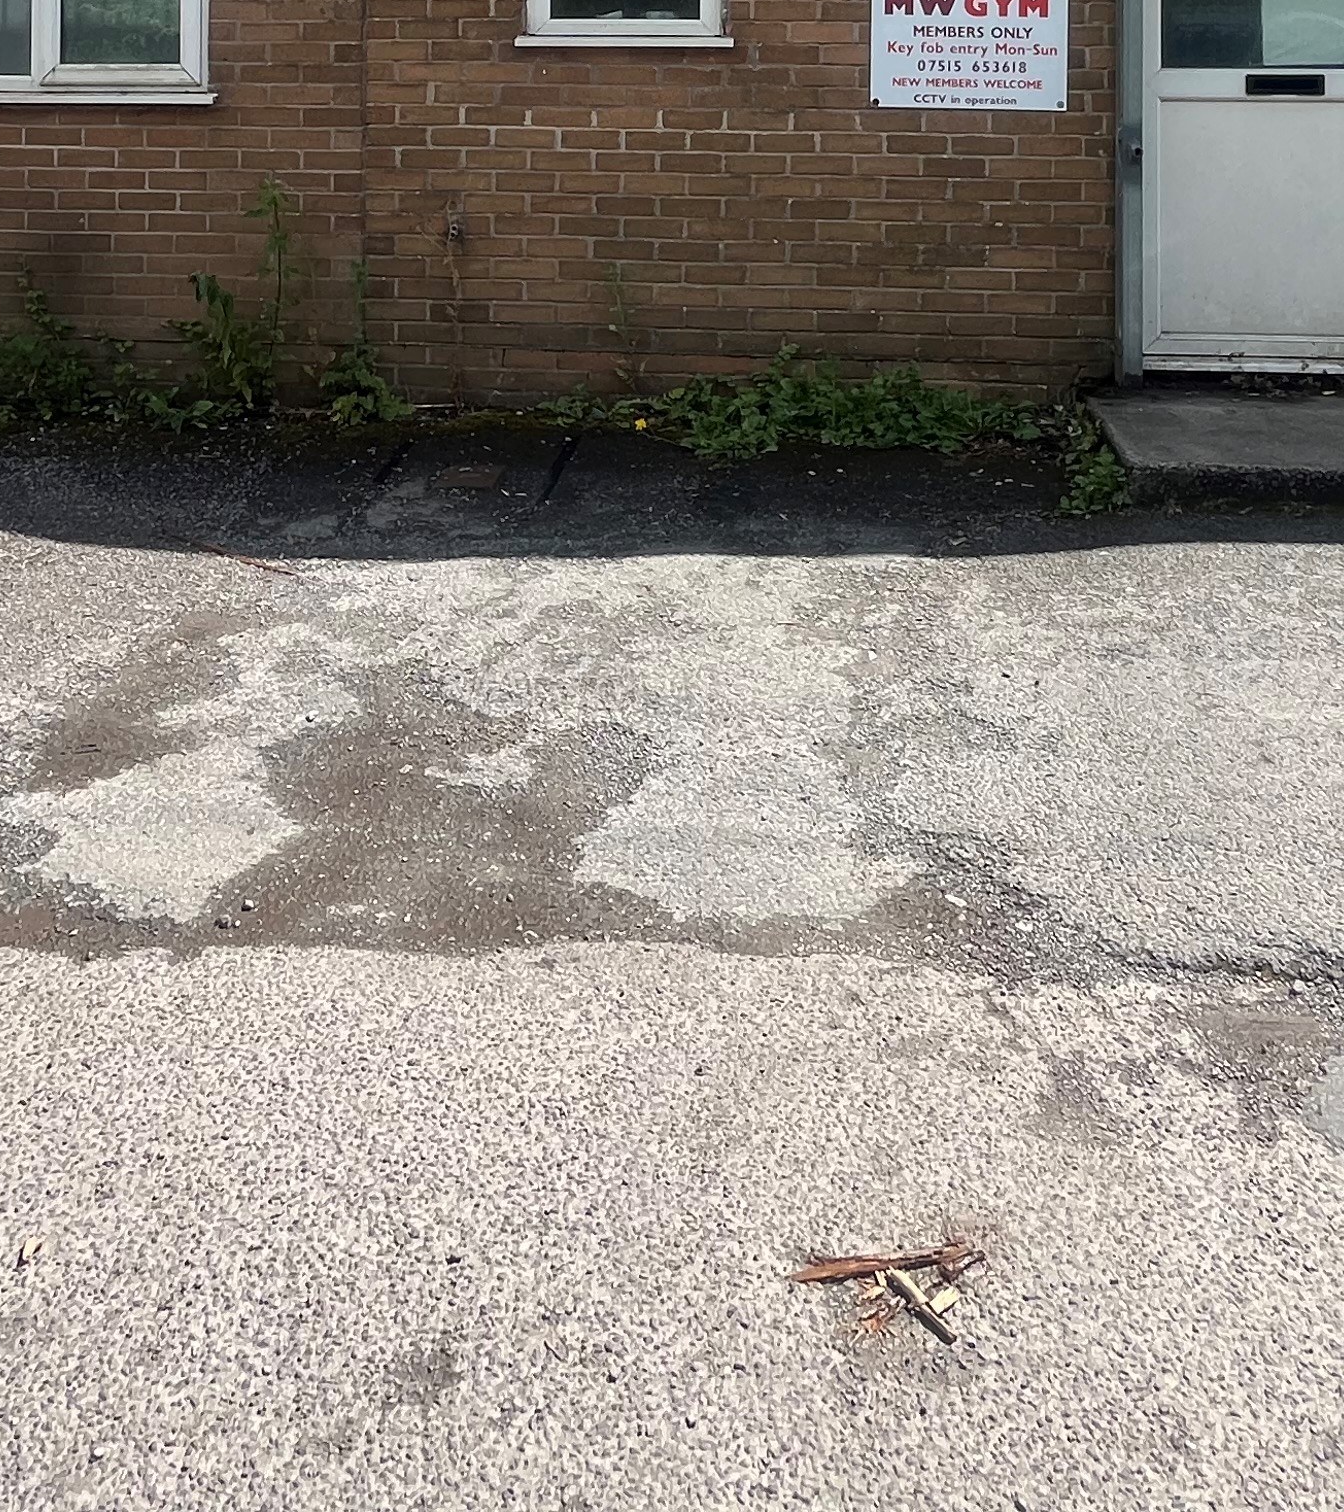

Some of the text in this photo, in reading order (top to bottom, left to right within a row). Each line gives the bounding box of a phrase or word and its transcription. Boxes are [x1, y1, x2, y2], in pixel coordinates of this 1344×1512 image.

[913, 25, 1033, 39] MEMBERS ONLY
[887, 41, 1058, 58] Key fob entry Mon-Sun
[917, 60, 1027, 73] 07515 653618
[892, 77, 1042, 90] NEW MEMBERS WELCOME
[914, 94, 1017, 106] CCTV in operation
